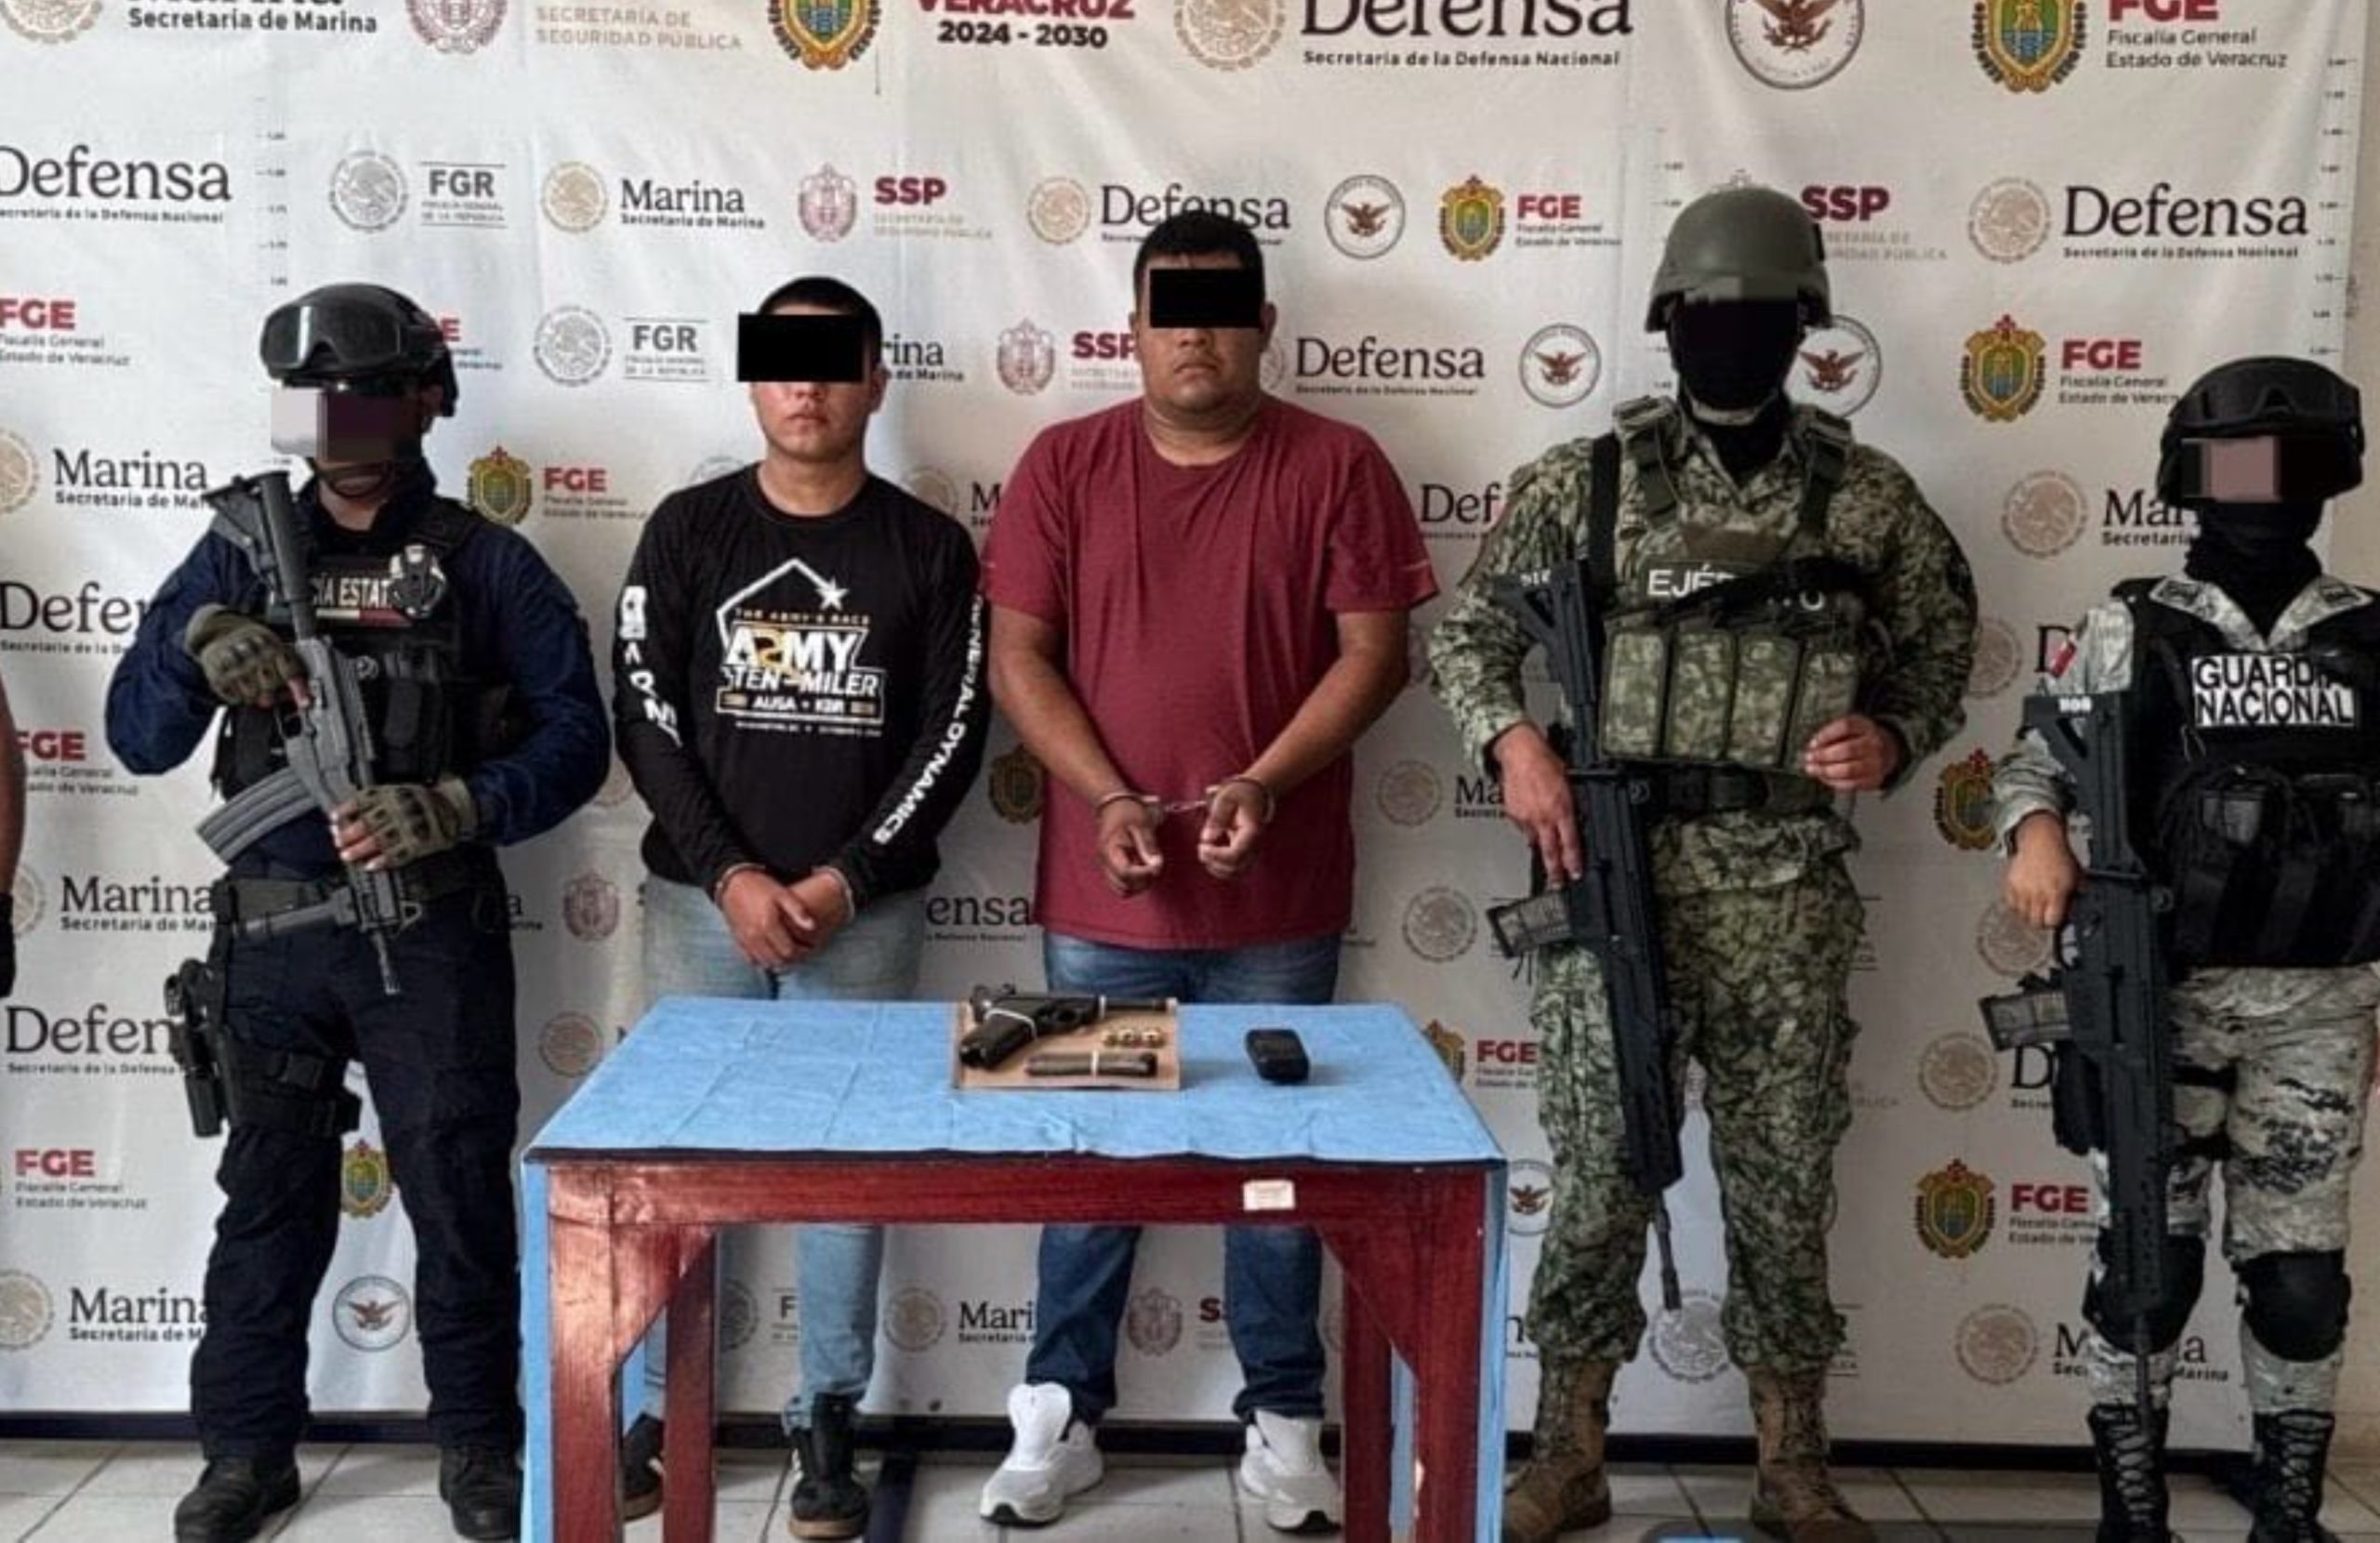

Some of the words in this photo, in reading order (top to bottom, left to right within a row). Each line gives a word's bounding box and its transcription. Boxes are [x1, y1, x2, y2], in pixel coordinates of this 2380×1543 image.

[258, 9, 287, 31] de
[294, 11, 377, 33] Marina
[665, 9, 691, 29] DE
[1301, 0, 1634, 37] Defensa
[536, 28, 652, 46] SEGURIDAD
[938, 20, 1011, 45] 2024
[1036, 23, 1107, 48] 2030
[2181, 28, 2256, 46] General
[1407, 51, 1429, 66] de
[1434, 51, 1450, 66] la
[1456, 51, 1530, 67] Defensa
[1536, 50, 1620, 67] Nacional
[2106, 51, 2172, 69] Estado
[2176, 52, 2202, 69] de
[2207, 51, 2287, 70] Veracruz
[0, 145, 232, 202] Defensa
[430, 169, 495, 198] FGR
[620, 178, 746, 214] Marina
[874, 176, 947, 205] SSP
[1801, 185, 1890, 221] SSP
[102, 209, 159, 222] Defensa
[717, 215, 765, 229] Marina
[1517, 195, 1582, 220] FGE
[2063, 182, 2308, 238] Defensa
[2141, 246, 2158, 258] de
[2177, 247, 2234, 259] Defensa
[2238, 246, 2299, 258] Nacional
[0, 299, 76, 331] FGE
[633, 323, 697, 352] FGR
[1072, 331, 1136, 360] SSP
[1295, 336, 1484, 380] Defensa
[2061, 340, 2142, 370] FGE
[2110, 391, 2129, 404] de
[2132, 392, 2179, 405] Veracr
[54, 447, 208, 490] Marina
[544, 466, 606, 493] FGE
[147, 492, 170, 508] de
[173, 494, 205, 509] Mar
[2103, 489, 2186, 527] Mar
[0, 581, 141, 635] Defe
[725, 626, 858, 672] ARMY
[2195, 657, 2317, 689] GUARD
[2195, 690, 2354, 724] NACIONAL
[62, 876, 213, 914] Marina
[157, 916, 177, 930] de
[926, 895, 1032, 927] ensa
[5, 1002, 178, 1054] Defen
[1476, 1039, 1538, 1065] FGE
[16, 1149, 96, 1178] FGE
[2011, 1184, 2090, 1214] FGE
[959, 1300, 1034, 1329] Mari
[163, 1327, 183, 1343] de
